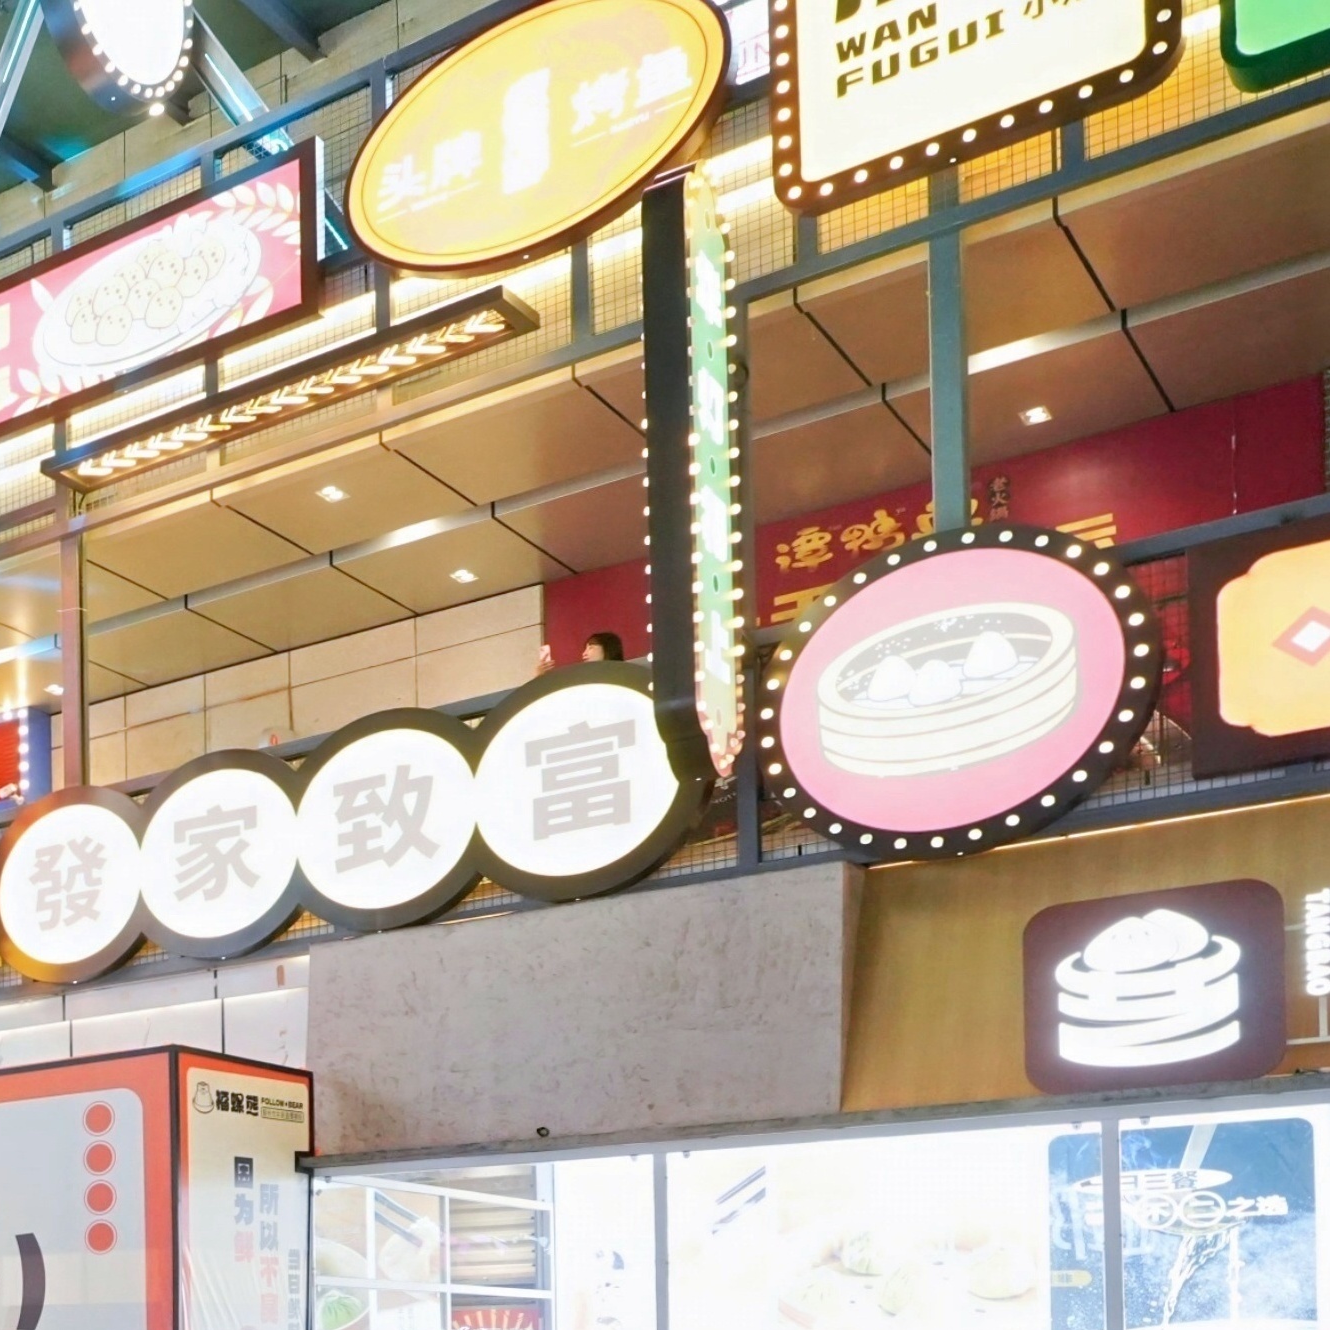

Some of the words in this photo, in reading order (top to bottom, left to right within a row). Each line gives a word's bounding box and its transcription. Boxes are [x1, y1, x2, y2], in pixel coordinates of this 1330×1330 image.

[835, 7, 938, 63] WAN
[836, 10, 1005, 98] FUGUI
[29, 720, 637, 932] 發家致富
